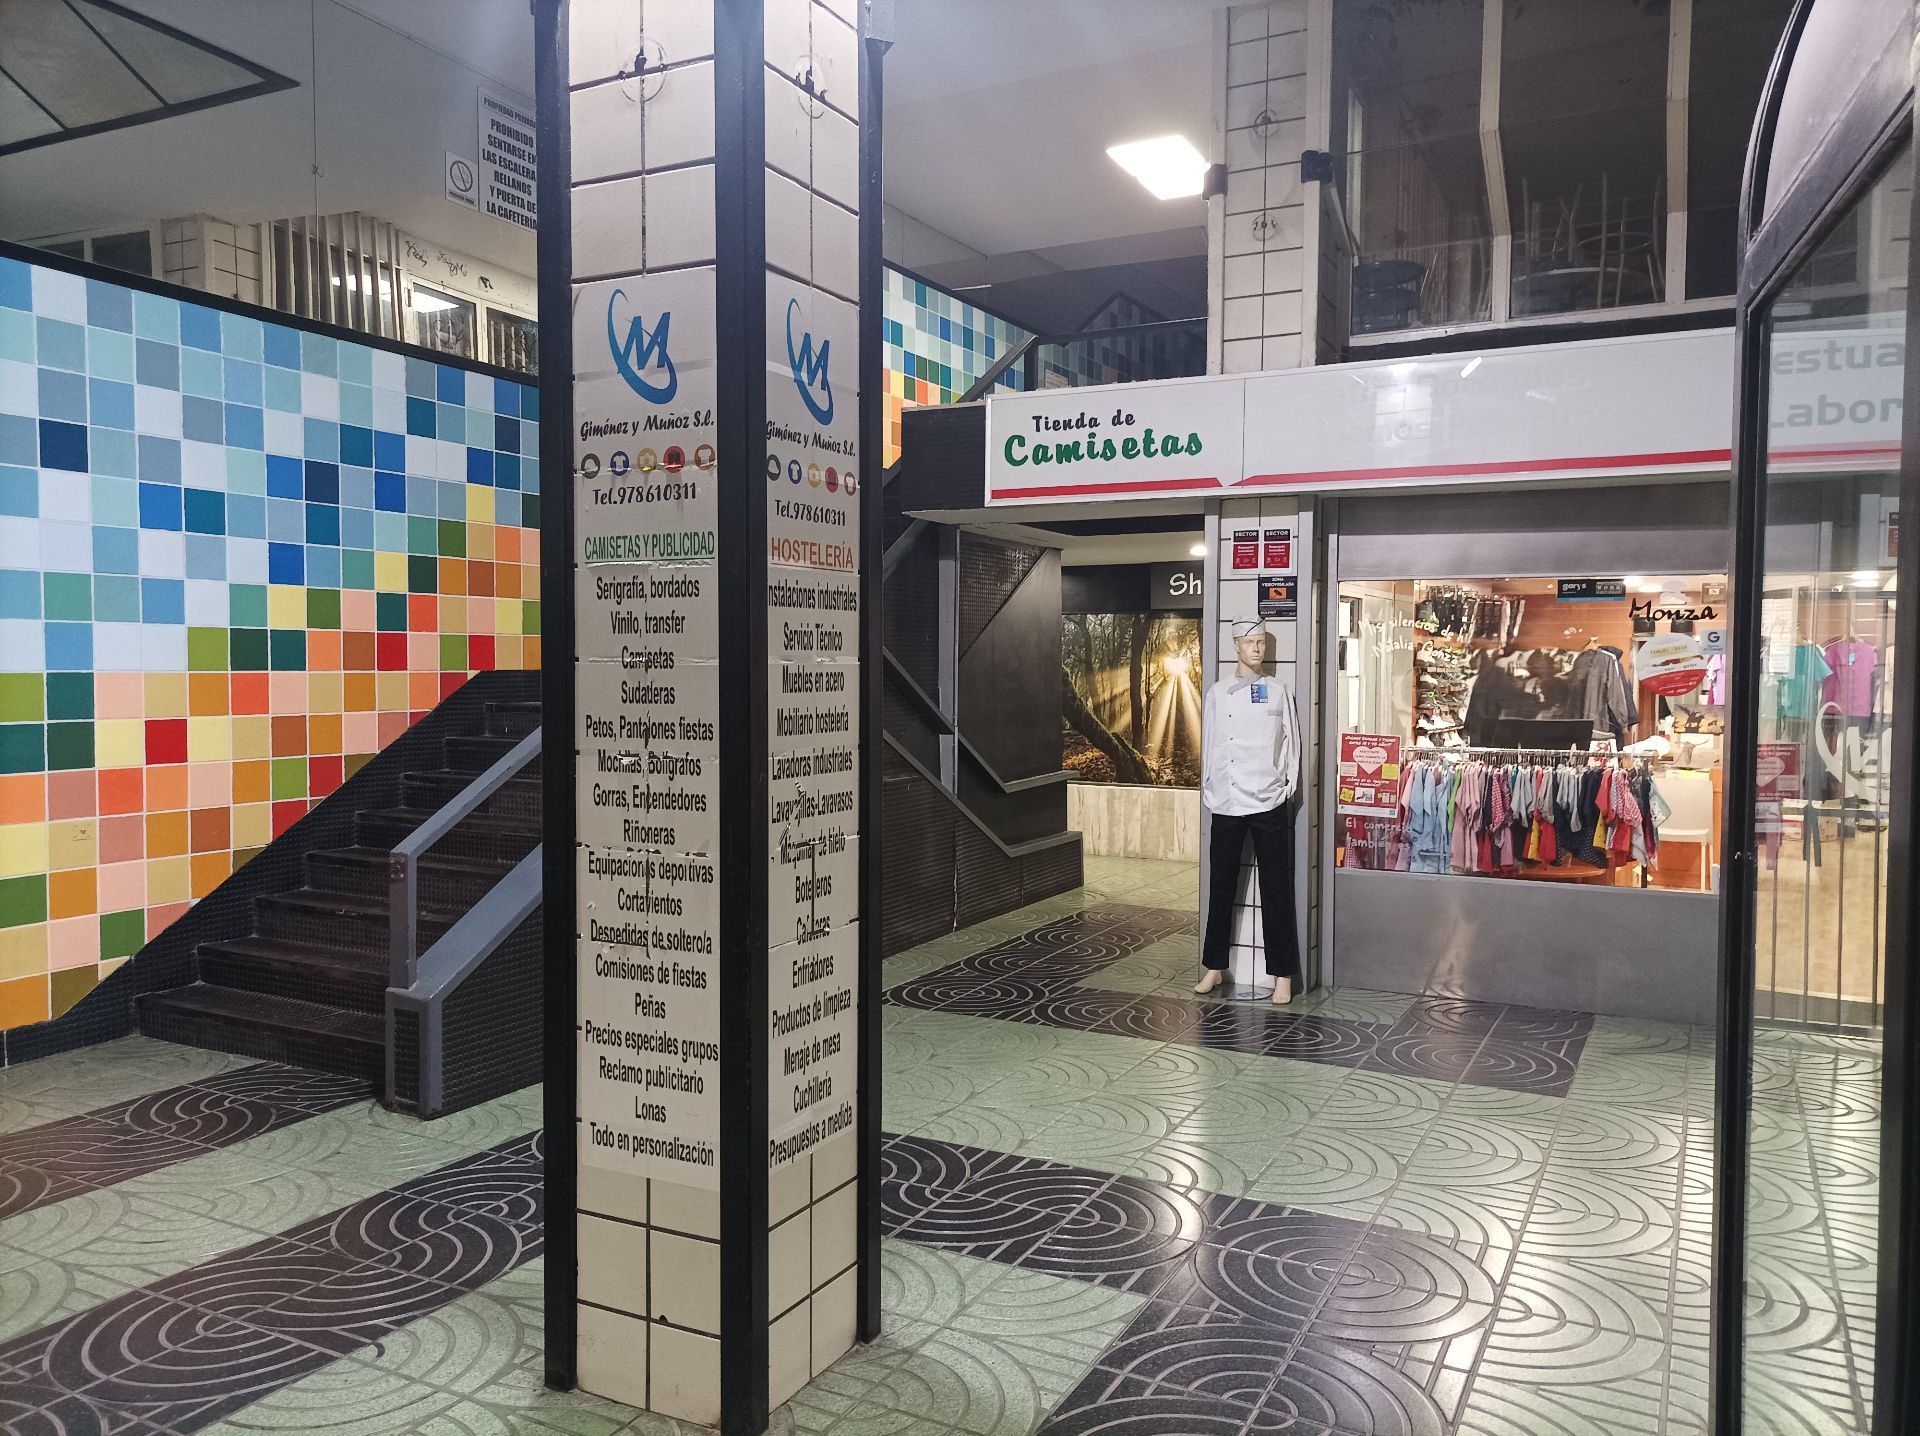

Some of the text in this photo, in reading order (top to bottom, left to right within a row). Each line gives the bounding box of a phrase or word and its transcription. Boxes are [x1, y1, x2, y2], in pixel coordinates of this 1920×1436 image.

[484, 97, 513, 119] PROPIEDAD
[488, 134, 526, 161] SENTARSE
[491, 119, 534, 149] PROHIBIDO
[482, 149, 537, 182] LAS ESCALERA
[494, 170, 532, 197] RELLANOS
[487, 201, 497, 215] LA
[490, 185, 495, 198] Y
[497, 188, 526, 211] PUERTA
[527, 201, 537, 215] DE
[1773, 340, 1905, 375] estua
[581, 418, 629, 442] Giménez
[632, 422, 640, 437] y
[643, 413, 690, 432] Muñoz
[1032, 409, 1136, 433] Tienda de
[766, 421, 802, 445] Giménez
[803, 434, 810, 447] y
[812, 432, 841, 454] Muñoz
[1004, 428, 1203, 467] Camisetas
[593, 482, 697, 505] Tel.978610311
[775, 500, 846, 527] Tel.978610311
[584, 531, 715, 560] CAMISETAS Y PUBLICIDAD
[771, 537, 854, 570] HOSTELERÍA
[597, 574, 700, 606] Serigrafía, bordados
[769, 579, 857, 612] nstalaciones industriales
[1170, 573, 1202, 596] Sh
[611, 610, 686, 639] Vinilo, transfer
[1629, 598, 1718, 622] Monza
[783, 621, 843, 652] Servicio Técnico
[622, 646, 675, 670] Camisetas
[621, 681, 676, 705] Sudaderas
[782, 665, 845, 694] Muebles en acero
[586, 715, 714, 742] Petos, Pantalones fiestas
[777, 704, 849, 737] Mobiliario hostelería
[772, 745, 853, 781] Lavadoras industriales
[593, 783, 630, 812] Gorras,
[623, 819, 676, 846] Riñoneras
[1346, 817, 1357, 829] El
[819, 829, 828, 857] de
[828, 825, 846, 855] hielo
[588, 851, 714, 887] Equipacions deportivas
[618, 888, 683, 917] Cortavientos
[795, 872, 832, 904] Boteleros
[591, 919, 713, 955] Despedidas de soltero/a
[595, 954, 708, 990] Comisiones de fiestas
[793, 953, 834, 989] Enfriadores
[635, 993, 667, 1020] Peñas
[773, 986, 852, 1039] Productos de limpieza
[586, 1020, 719, 1066] Precios especiales grupos
[783, 1032, 842, 1077] Menaje de mesa
[600, 1056, 704, 1095] Reclamo publicitario
[793, 1070, 833, 1114] Cuchillería
[635, 1096, 667, 1124] Lonas
[590, 1121, 714, 1167] Todo en personalización
[770, 1099, 853, 1169] Presupuestos a medida
